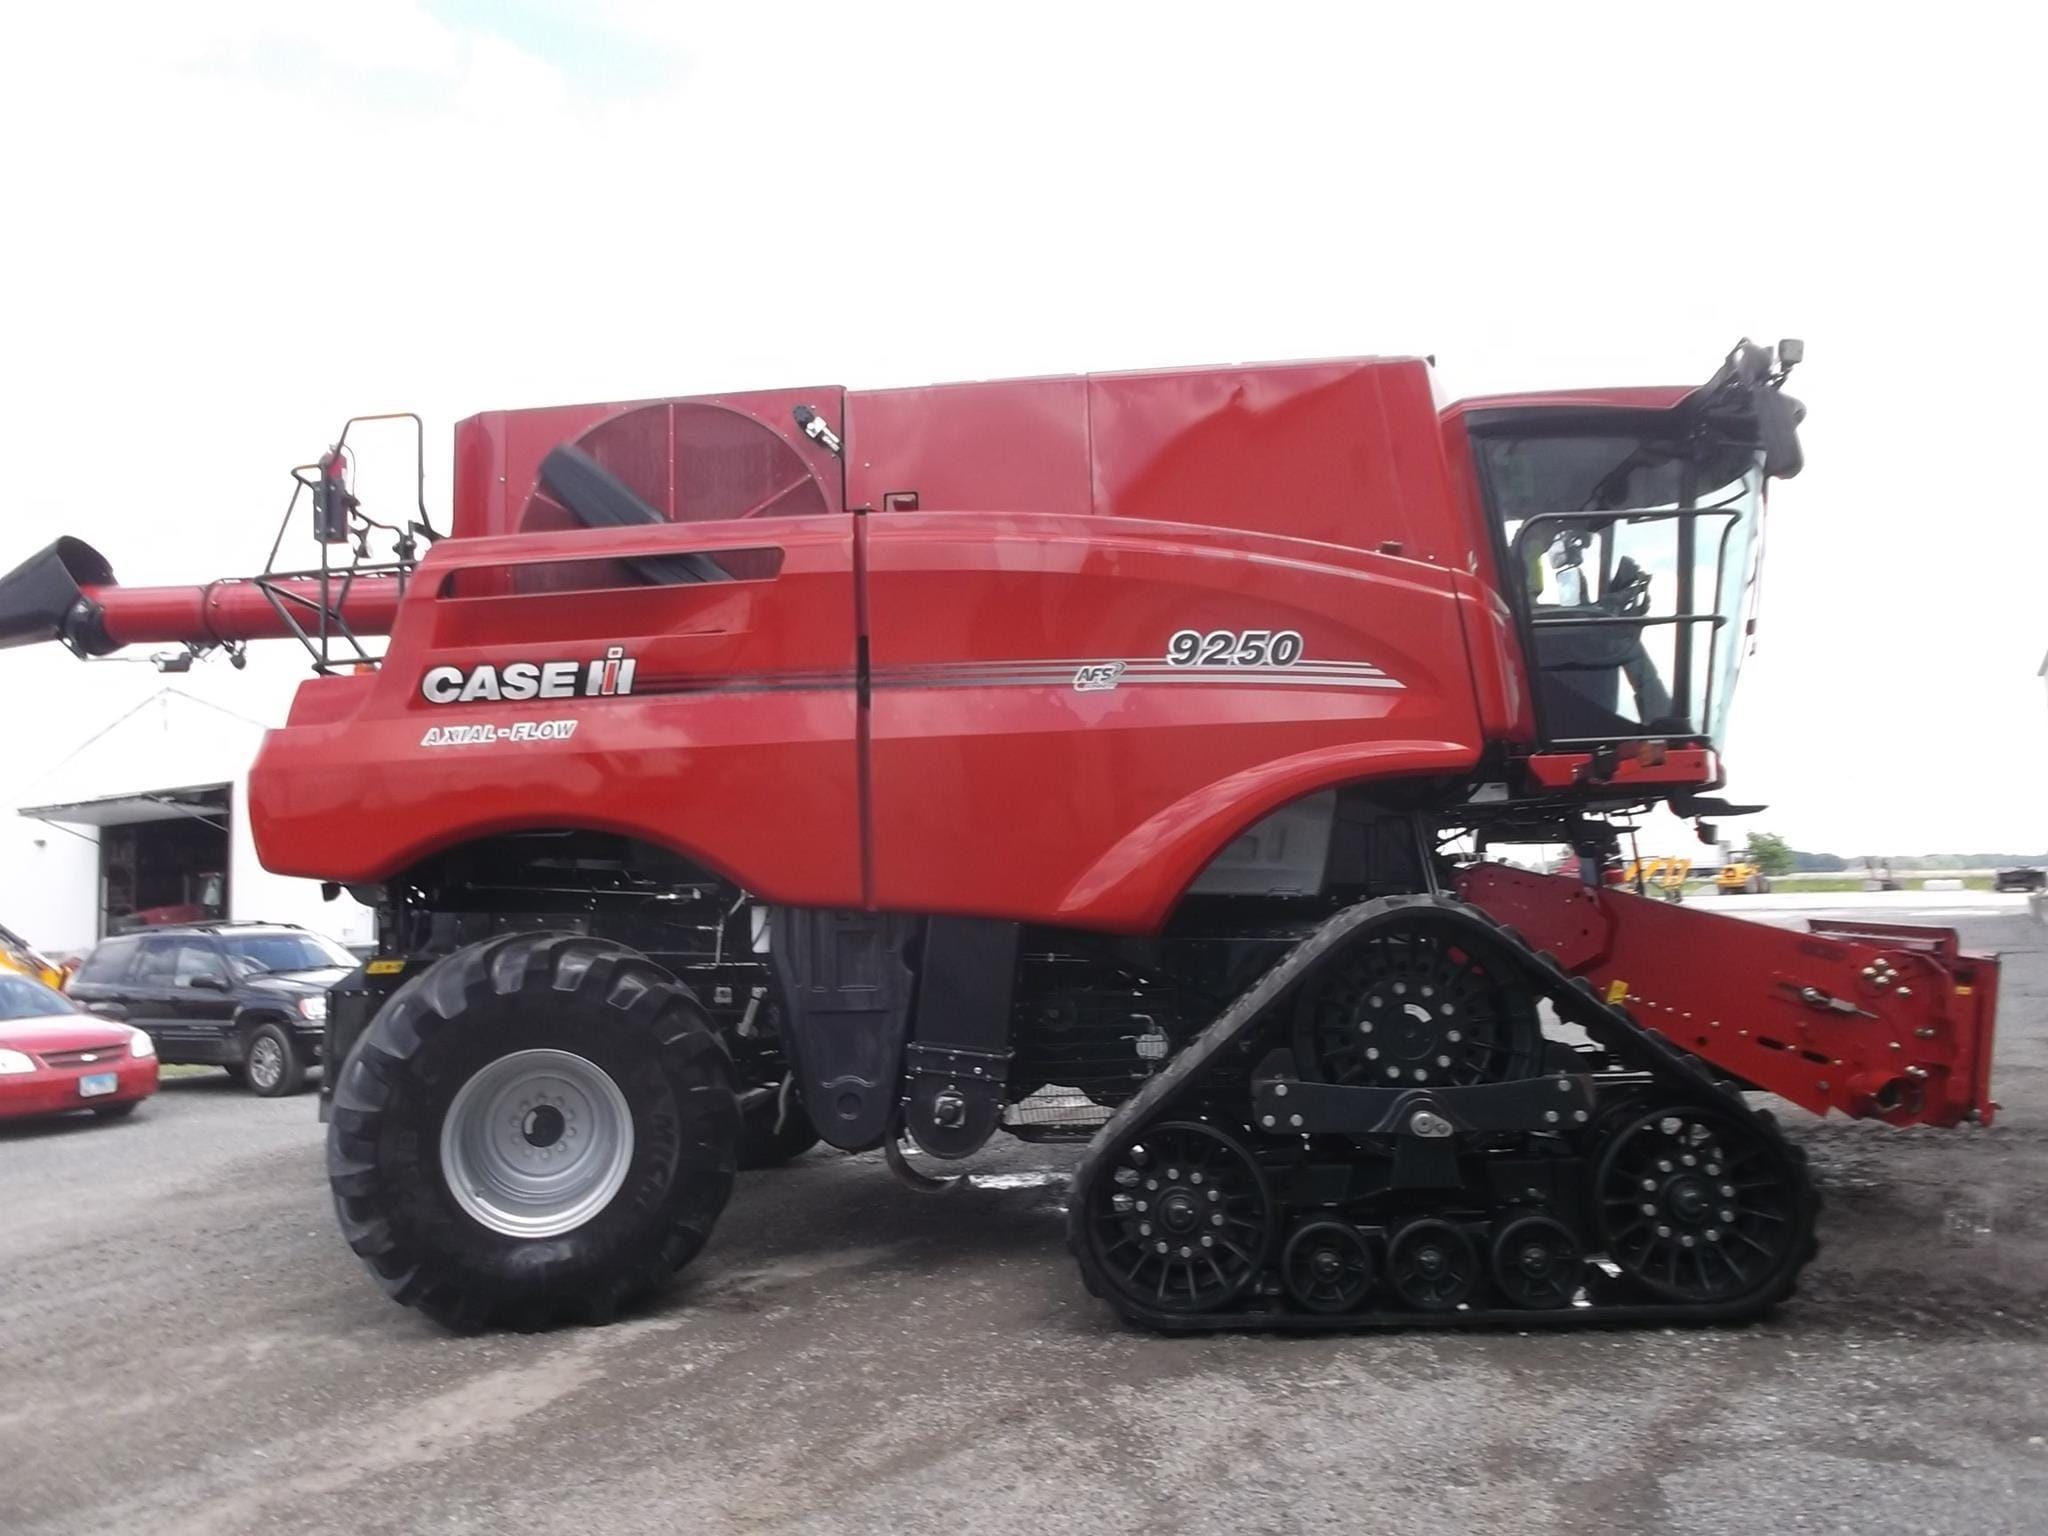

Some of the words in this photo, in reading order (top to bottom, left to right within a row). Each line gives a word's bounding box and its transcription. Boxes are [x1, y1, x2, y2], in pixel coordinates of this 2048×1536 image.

[1167, 630, 1303, 668] 9250
[422, 662, 580, 704] CASE
[1074, 665, 1116, 683] AFS
[420, 719, 578, 747] AXIAL-FLOW
